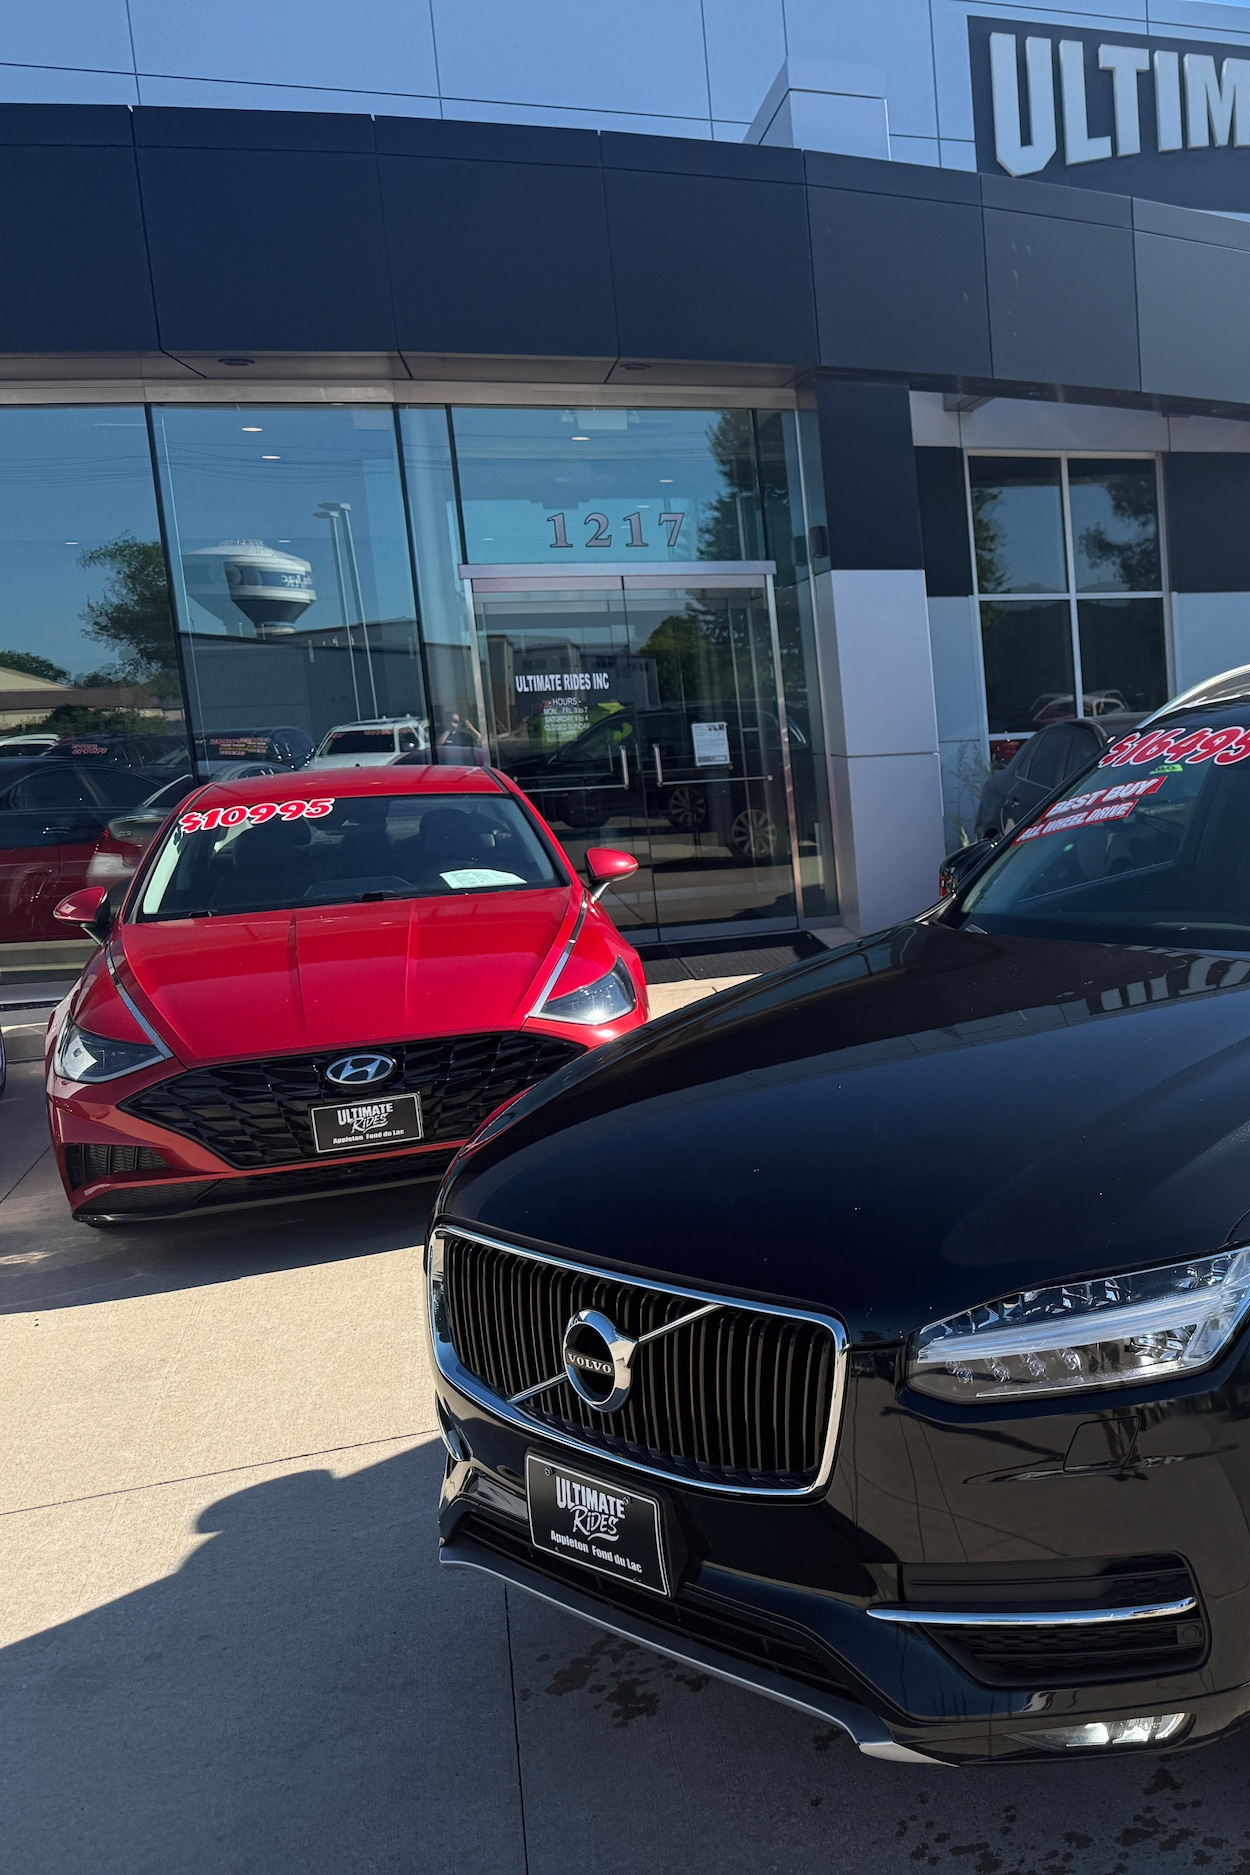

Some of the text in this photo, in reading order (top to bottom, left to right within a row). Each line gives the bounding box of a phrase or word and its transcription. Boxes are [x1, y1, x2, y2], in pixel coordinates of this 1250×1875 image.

[547, 512, 685, 548] 1217
[515, 672, 610, 693] ULTIMATE RIDES INC
[552, 697, 578, 706] HOURS
[179, 798, 337, 834] $10995
[1045, 778, 1160, 818] BEST BUY
[1016, 802, 1134, 842] ALL WHEEL DRIVE
[337, 1103, 394, 1126] ULTIMATE
[333, 1134, 364, 1145] Appleton
[366, 1131, 382, 1140] Fond
[567, 1353, 612, 1373] VOLVO
[555, 1476, 626, 1519] ULTIMATE
[550, 1529, 643, 1574] Appleton Fond du Lac
